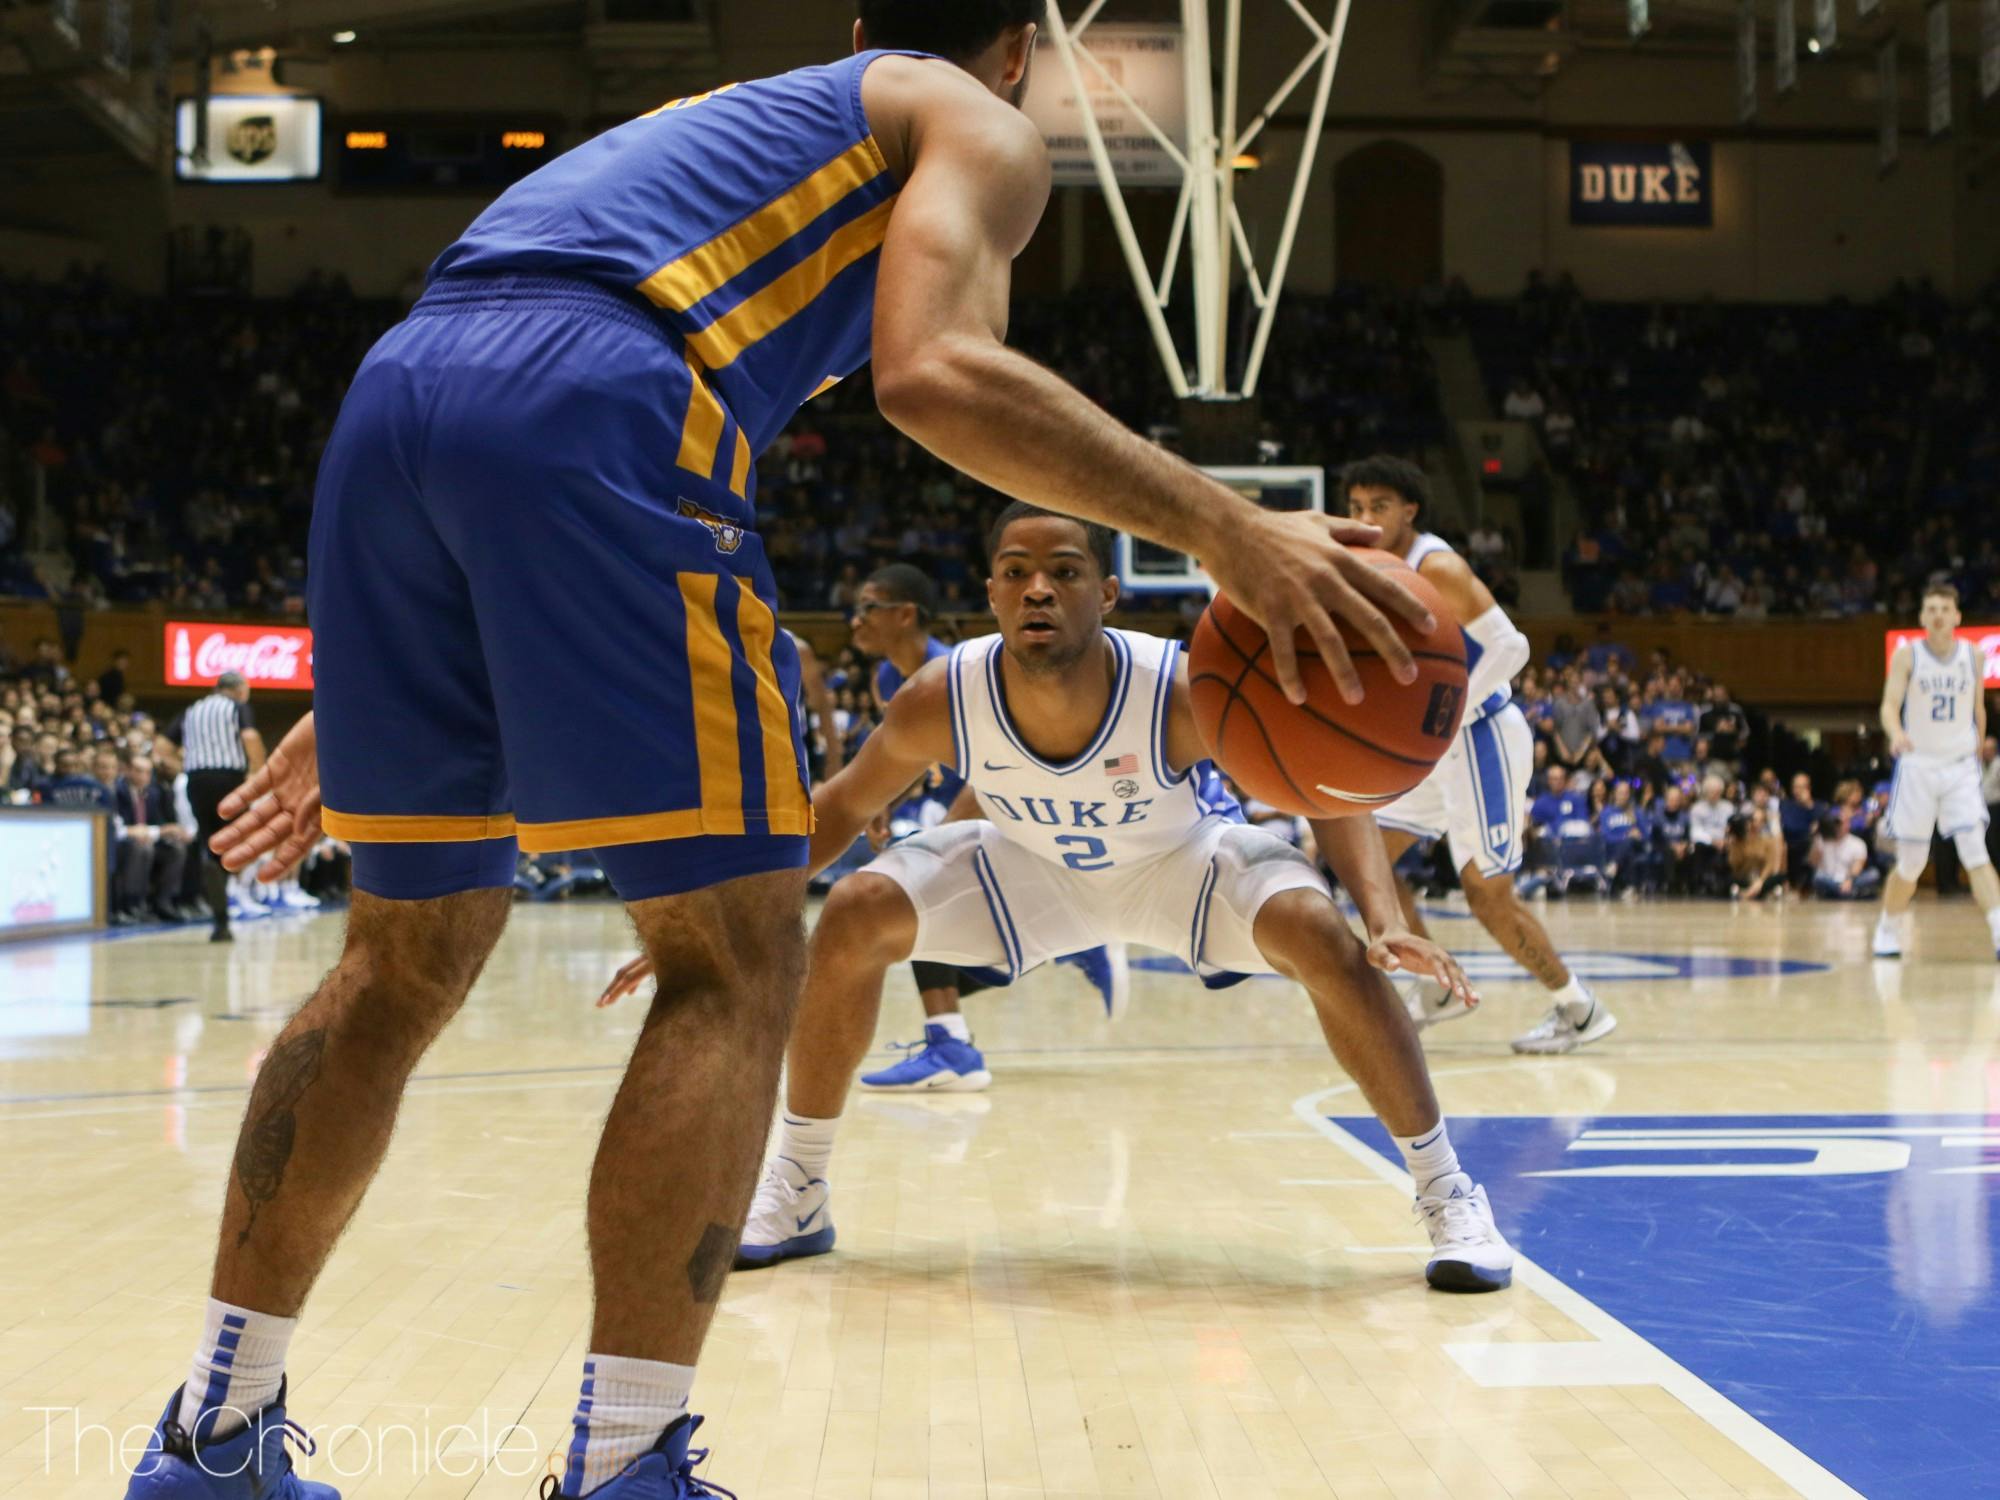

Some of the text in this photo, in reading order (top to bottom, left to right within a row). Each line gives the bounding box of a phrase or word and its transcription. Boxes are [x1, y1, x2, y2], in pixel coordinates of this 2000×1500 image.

[1581, 163, 1700, 204] DUKE
[1931, 694, 1955, 721] 21
[981, 791, 1154, 828] DUKE
[1054, 834, 1115, 871] 2
